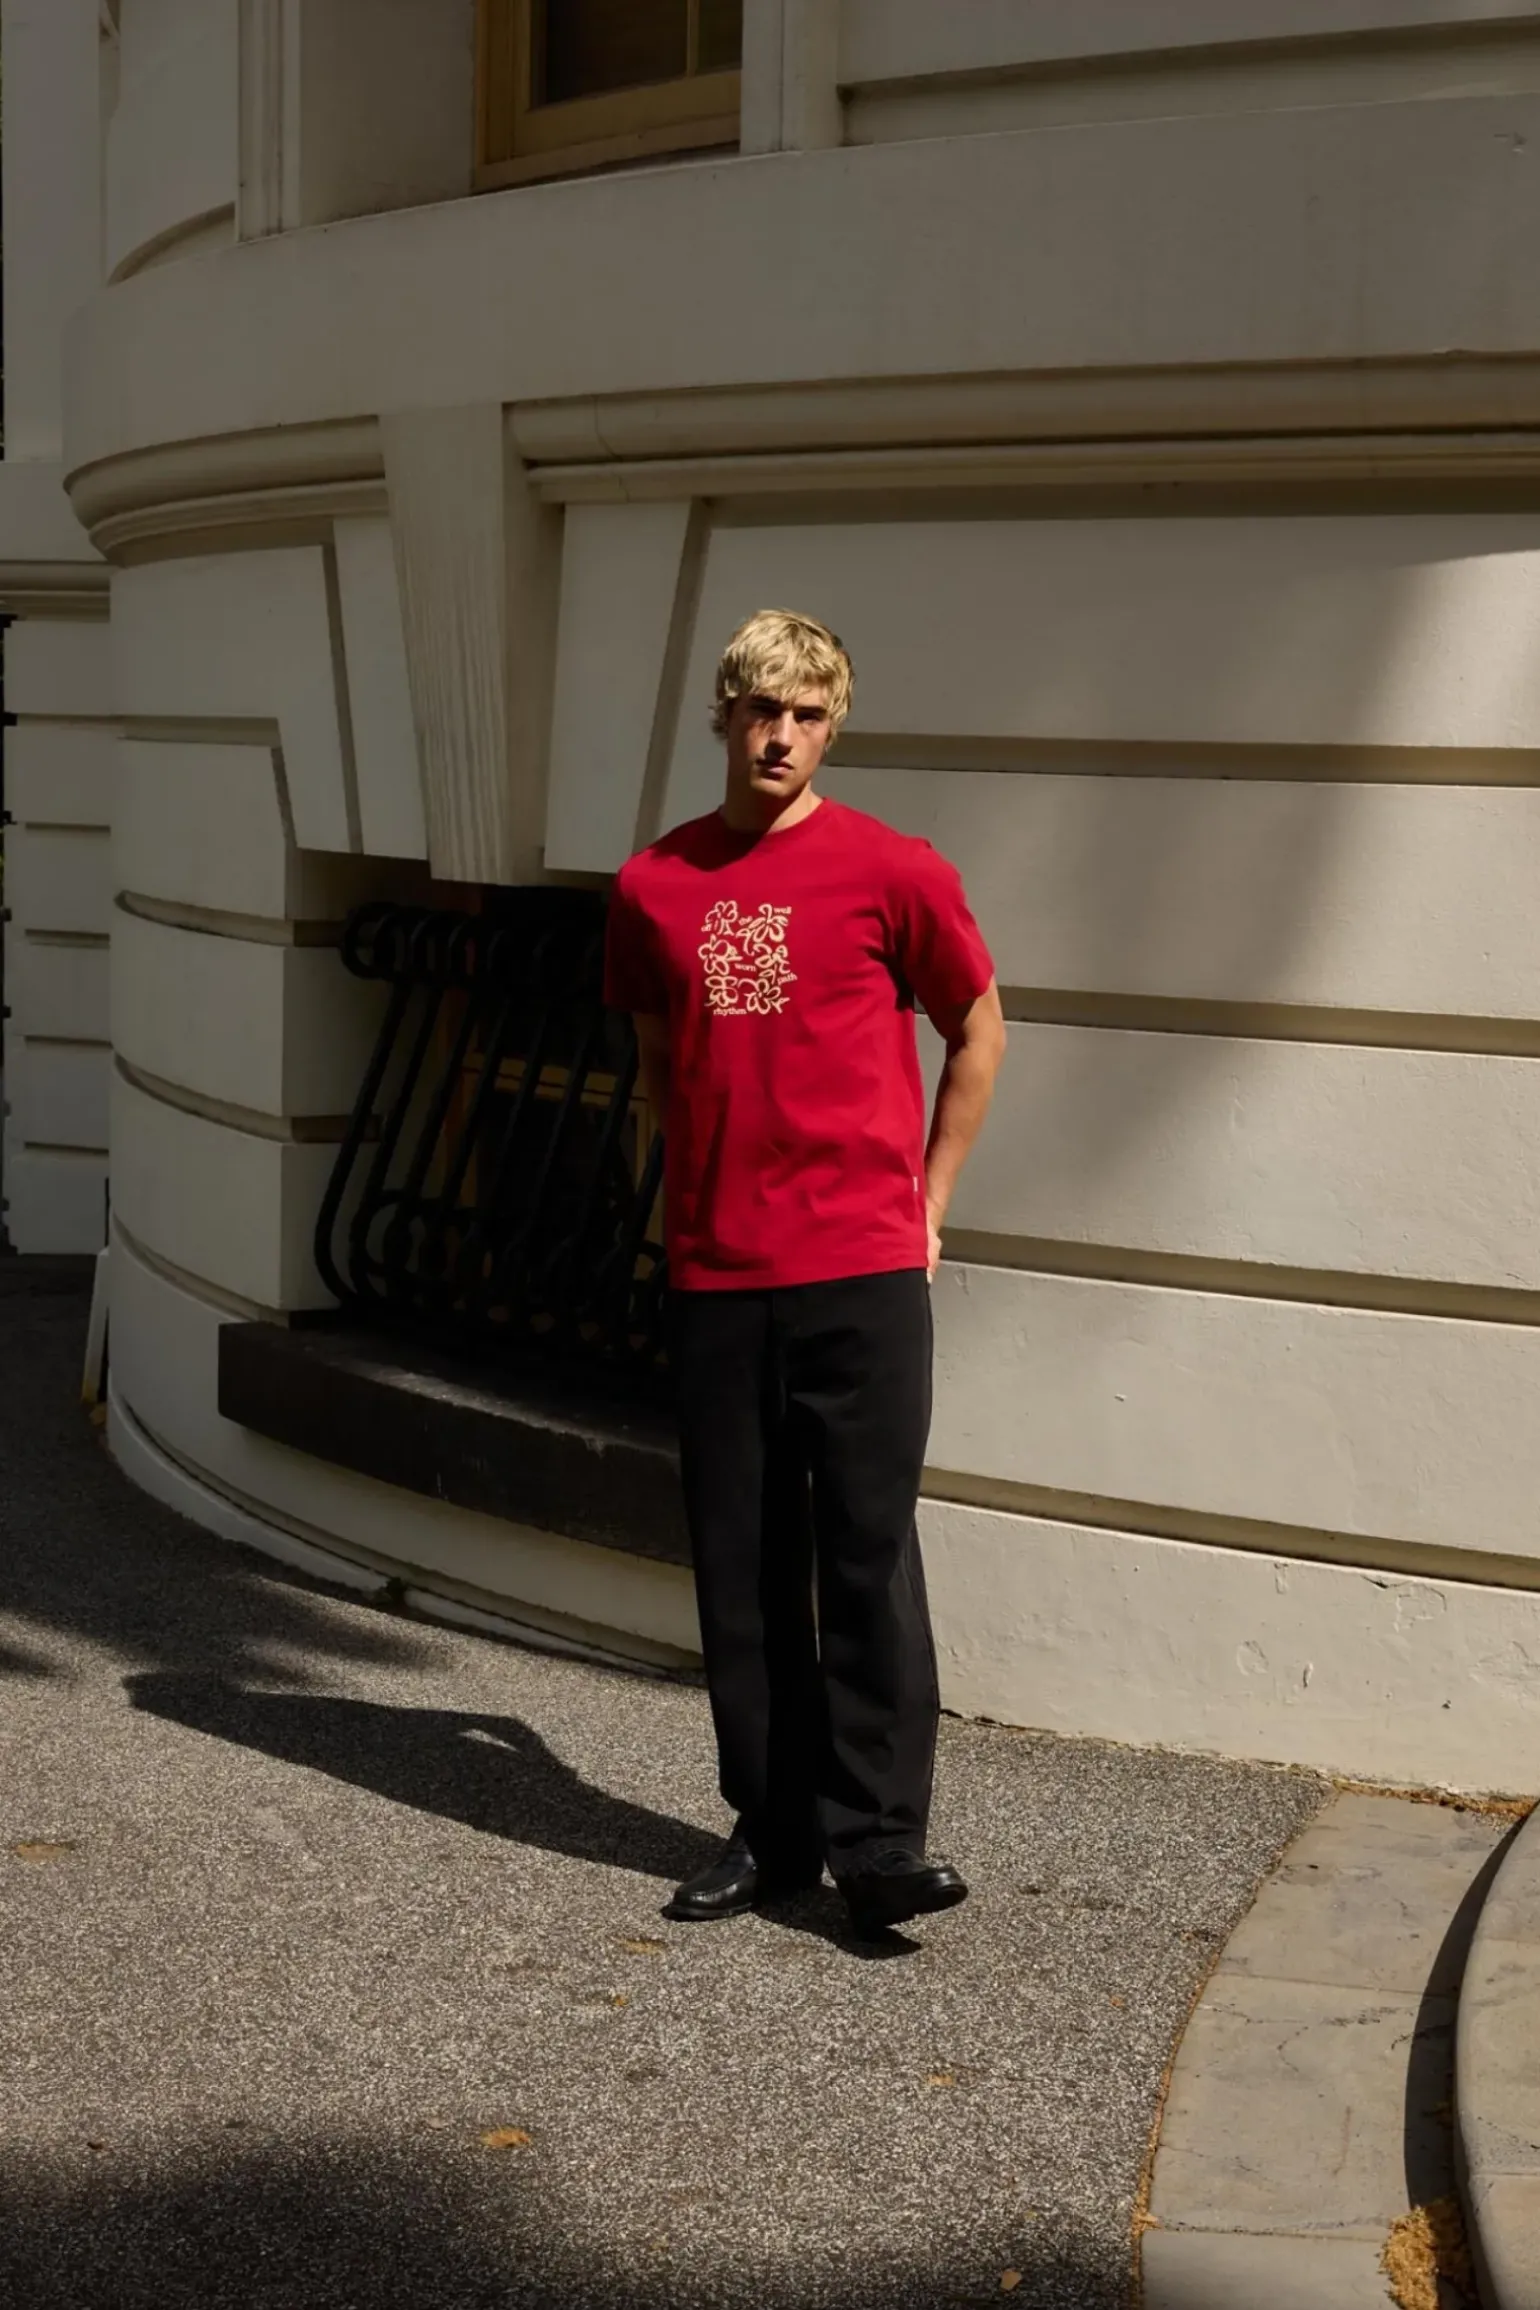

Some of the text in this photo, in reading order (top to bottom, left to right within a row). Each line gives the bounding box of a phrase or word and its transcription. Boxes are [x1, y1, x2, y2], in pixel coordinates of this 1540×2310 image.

[734, 963, 757, 972] worn
[776, 973, 798, 985] path
[713, 1007, 747, 1016] rhythm
